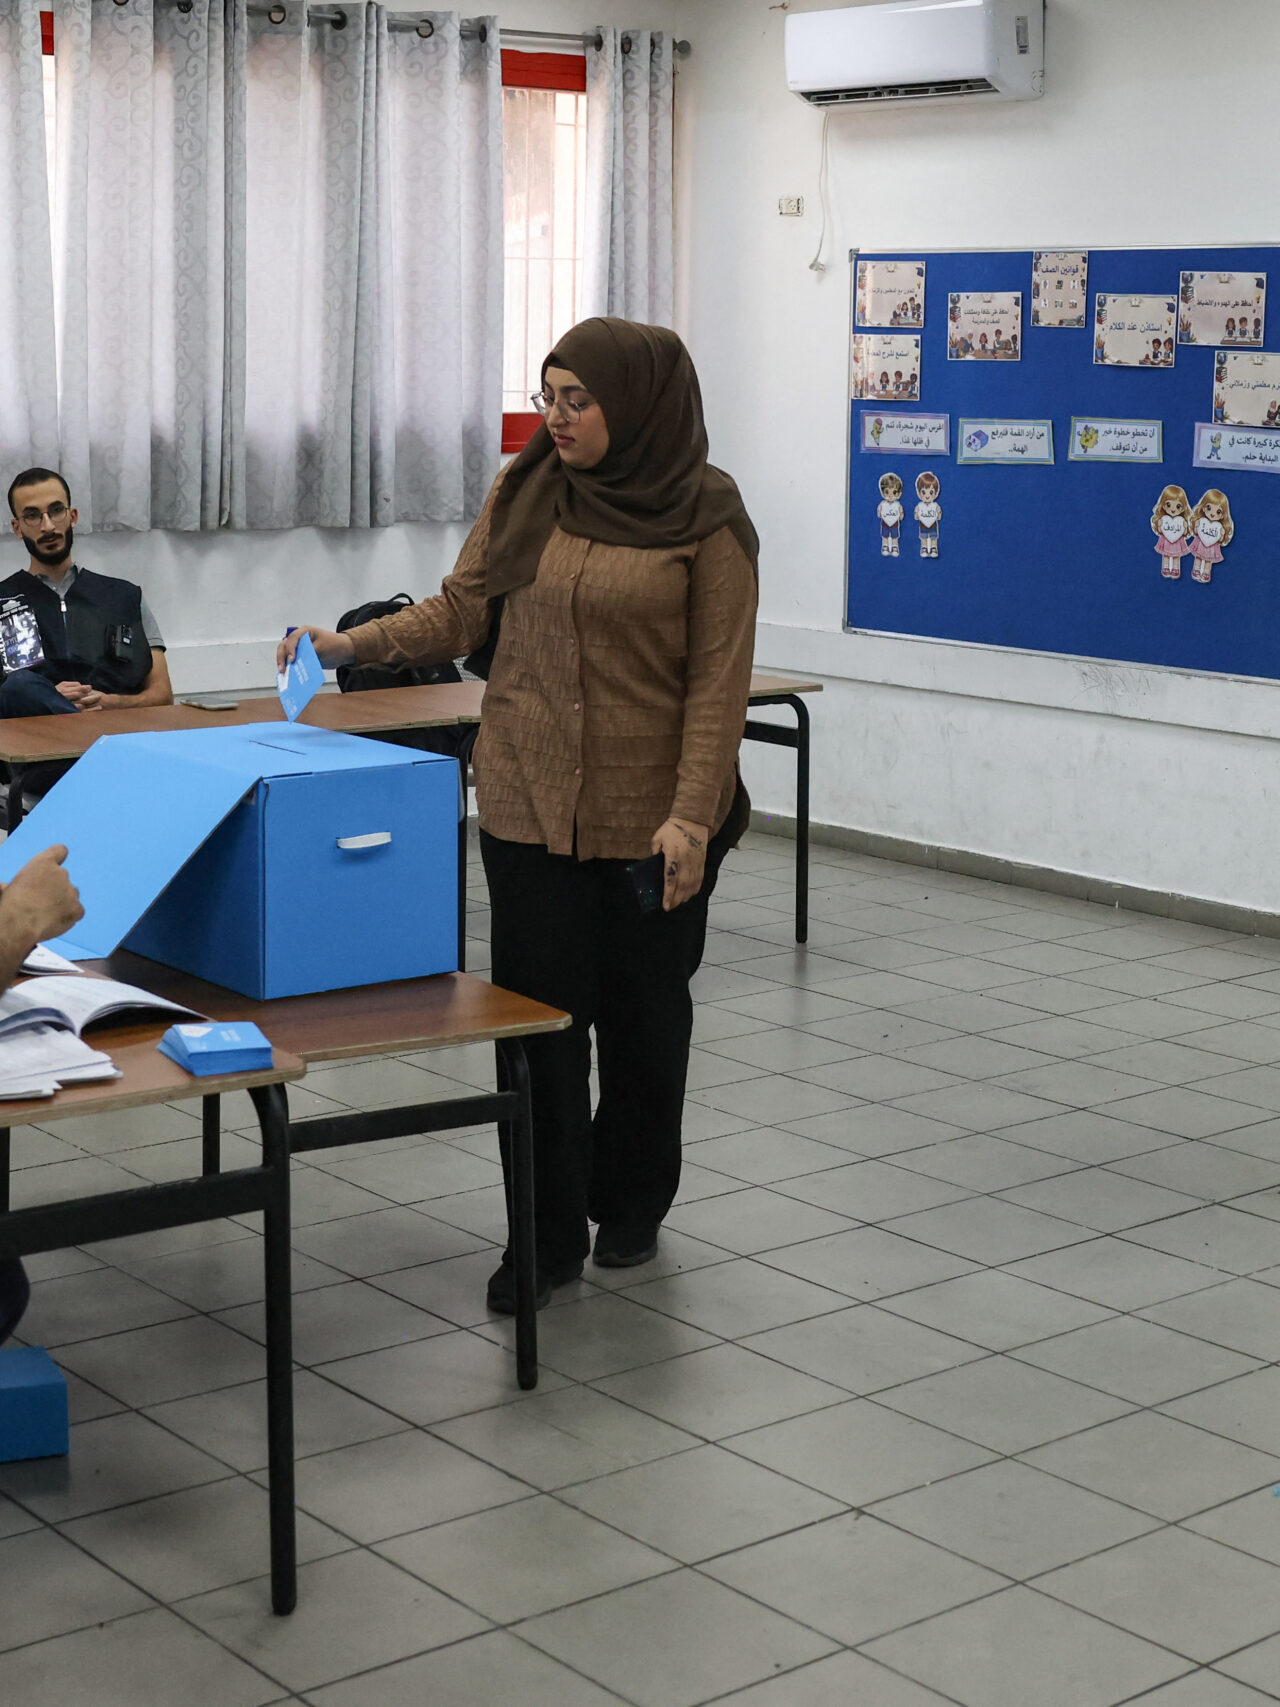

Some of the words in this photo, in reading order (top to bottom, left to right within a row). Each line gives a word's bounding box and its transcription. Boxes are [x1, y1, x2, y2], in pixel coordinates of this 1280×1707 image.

[1041, 265, 1059, 273] الصف
[1060, 264, 1079, 276] قوانين
[1109, 321, 1126, 332] الكلام
[1127, 322, 1137, 331] عند
[1036, 432, 1044, 440] من
[1102, 428, 1112, 437] خير
[1114, 428, 1130, 438] خطوة
[1131, 429, 1148, 439] تخطو
[1228, 435, 1235, 447] في
[1236, 436, 1252, 445] كانت
[1252, 438, 1268, 448] كبيرة
[1269, 438, 1280, 450] كرة
[1139, 446, 1147, 454] من
[1258, 452, 1279, 464] البداية
